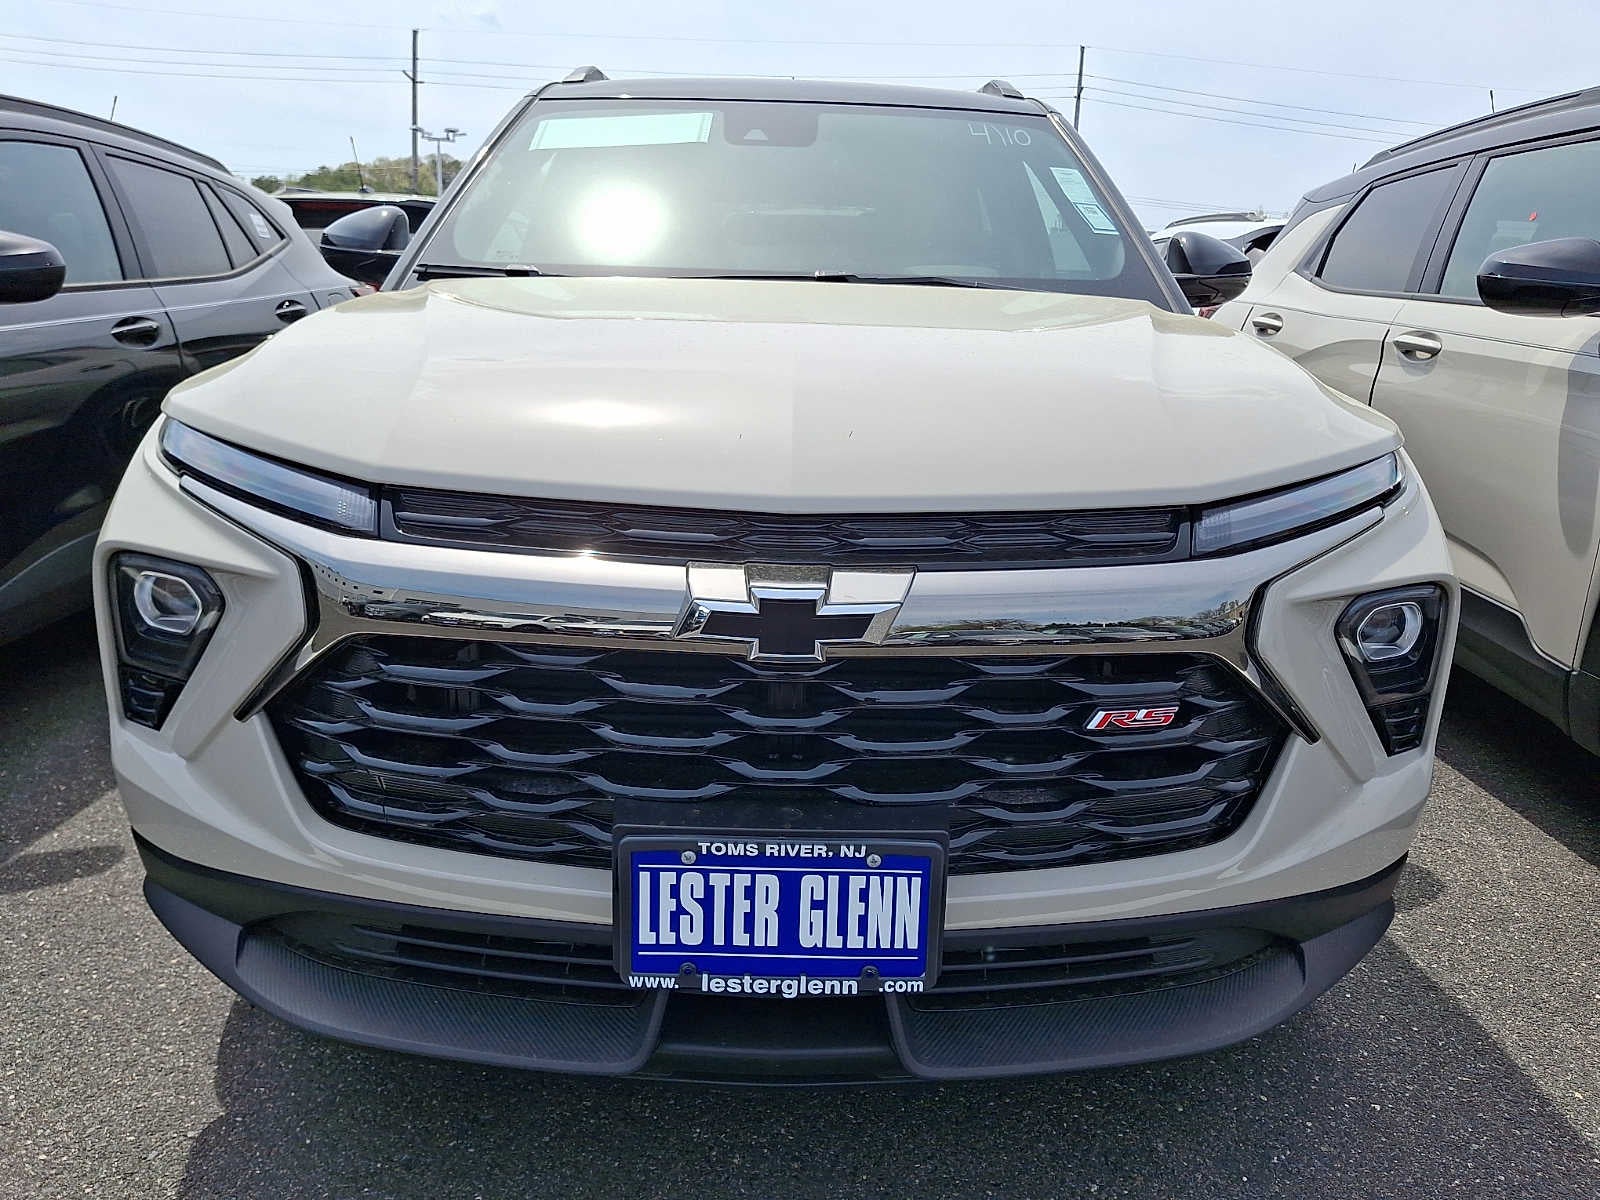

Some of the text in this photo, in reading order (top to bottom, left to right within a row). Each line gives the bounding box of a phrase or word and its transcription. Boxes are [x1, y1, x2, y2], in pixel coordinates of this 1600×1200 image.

[1086, 706, 1179, 730] RS
[698, 842, 867, 859] TOMS RIVER, NJ
[638, 871, 922, 949] LESTER GLENN
[629, 973, 924, 998] www. lesterglenn .com
